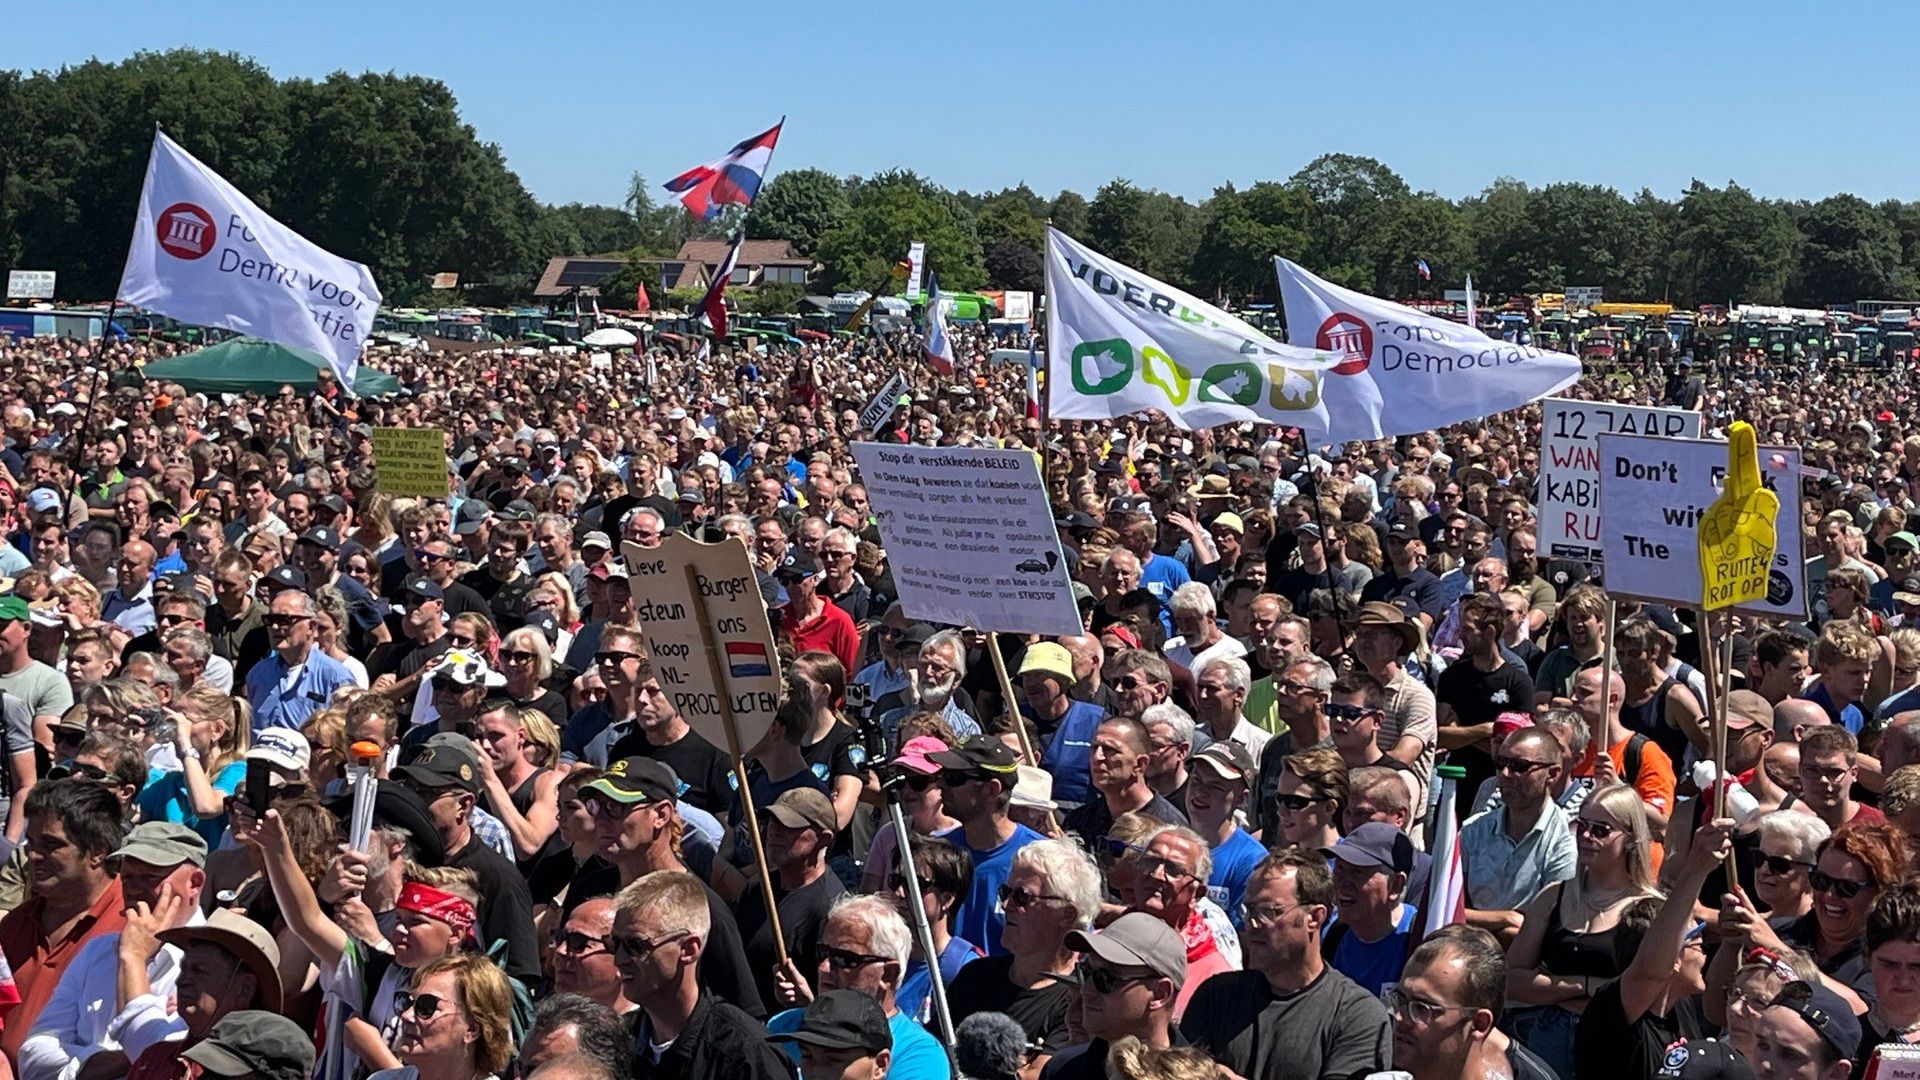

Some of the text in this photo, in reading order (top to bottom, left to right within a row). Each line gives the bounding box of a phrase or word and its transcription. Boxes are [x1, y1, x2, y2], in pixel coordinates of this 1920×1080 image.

[308, 274, 366, 310] voor
[1554, 411, 1588, 440] 12
[878, 451, 900, 464] Stop
[902, 453, 914, 464] dit
[918, 456, 983, 468] verstikkende
[883, 473, 899, 482] Den
[900, 474, 920, 488] Haag
[922, 476, 962, 487] beweren
[974, 478, 988, 488] dat
[989, 479, 1020, 490] koeien
[928, 494, 956, 504] zorgen
[961, 494, 973, 504] als
[977, 494, 992, 504] het
[1624, 536, 1670, 560] The
[624, 554, 749, 602] Lieve Burger
[1710, 582, 1736, 604] ROT
[1742, 577, 1764, 594] OP
[639, 598, 746, 634] steun ons
[650, 638, 689, 661] koop
[661, 666, 690, 684] NL-
